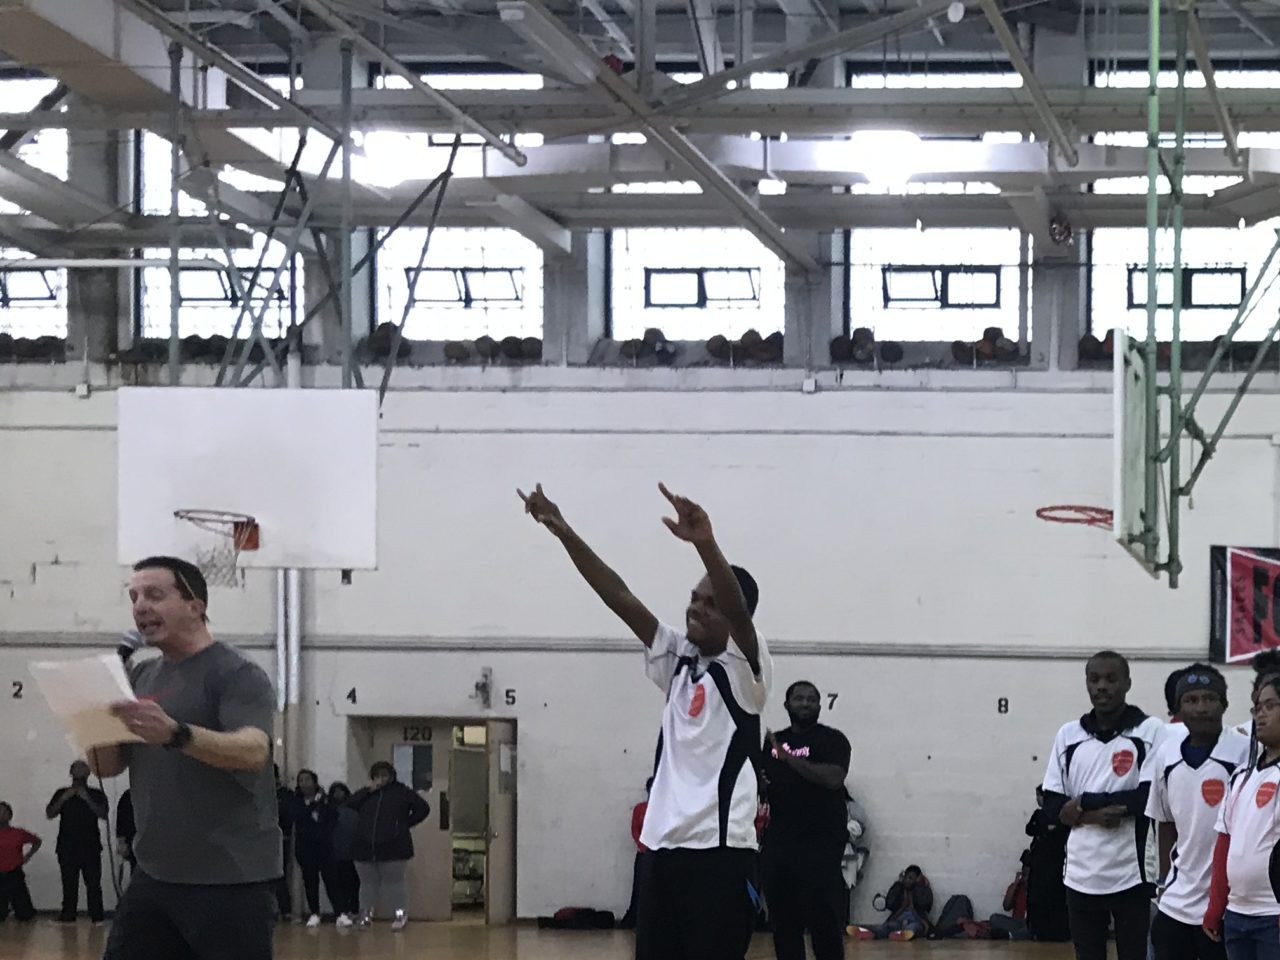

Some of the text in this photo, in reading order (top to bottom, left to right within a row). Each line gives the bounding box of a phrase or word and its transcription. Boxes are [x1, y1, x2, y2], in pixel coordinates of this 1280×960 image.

[12, 681, 23, 699] 2
[347, 687, 357, 704] 4
[505, 689, 516, 706] 5
[827, 693, 838, 710] 7
[998, 697, 1009, 714] 8
[403, 725, 433, 742] 120
